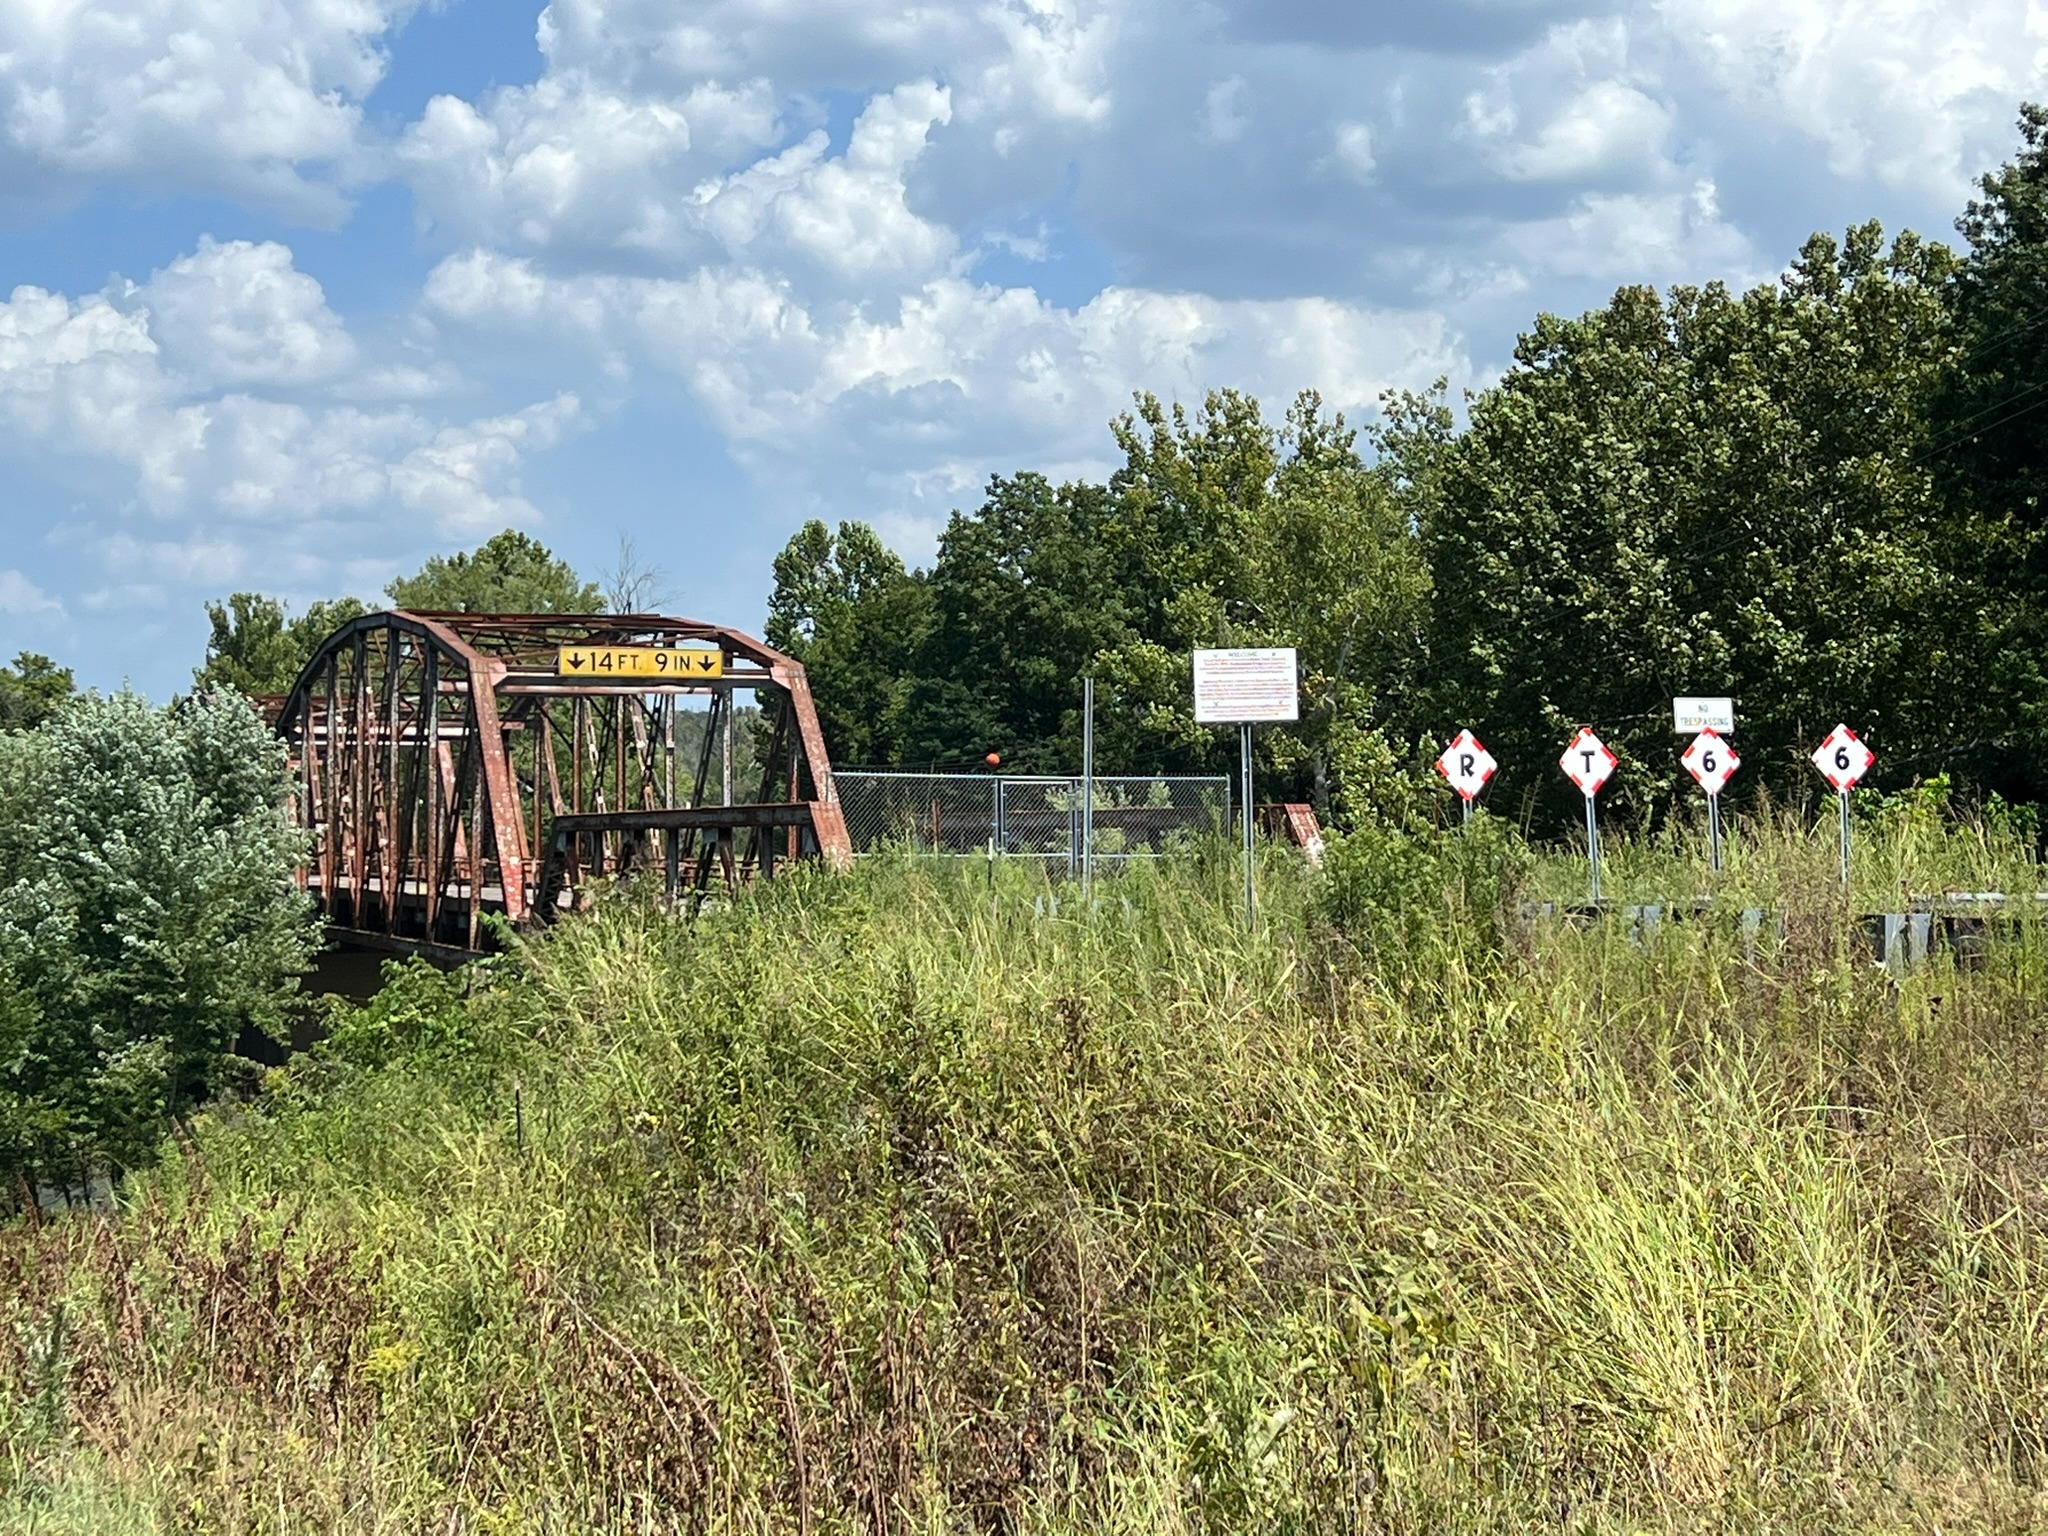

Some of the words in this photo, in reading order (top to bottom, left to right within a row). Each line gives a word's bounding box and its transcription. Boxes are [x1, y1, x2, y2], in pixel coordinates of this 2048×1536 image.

[590, 652, 613, 672] 14
[655, 653, 668, 672] 9
[1698, 704, 1709, 713] NO
[1680, 716, 1729, 727] TRESPASSING
[1460, 753, 1475, 777] R
[1580, 750, 1595, 774] T
[1703, 750, 1716, 772] 6
[1835, 746, 1850, 770] 6
